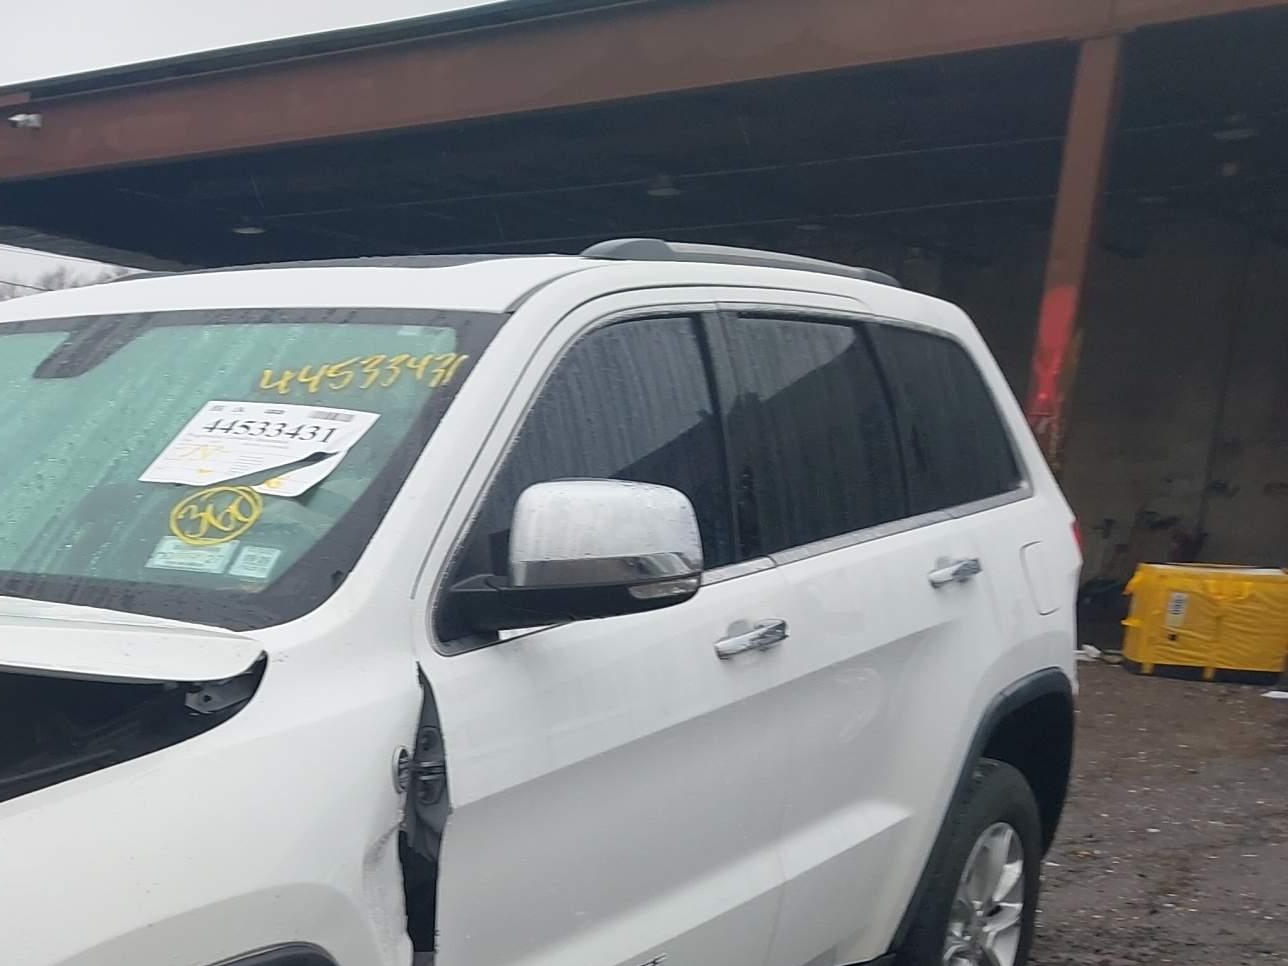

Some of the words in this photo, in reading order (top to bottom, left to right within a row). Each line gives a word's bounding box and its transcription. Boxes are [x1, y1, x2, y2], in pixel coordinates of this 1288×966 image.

[259, 353, 469, 394] 44533431
[203, 418, 338, 443] 44533431
[177, 494, 255, 538] 360
